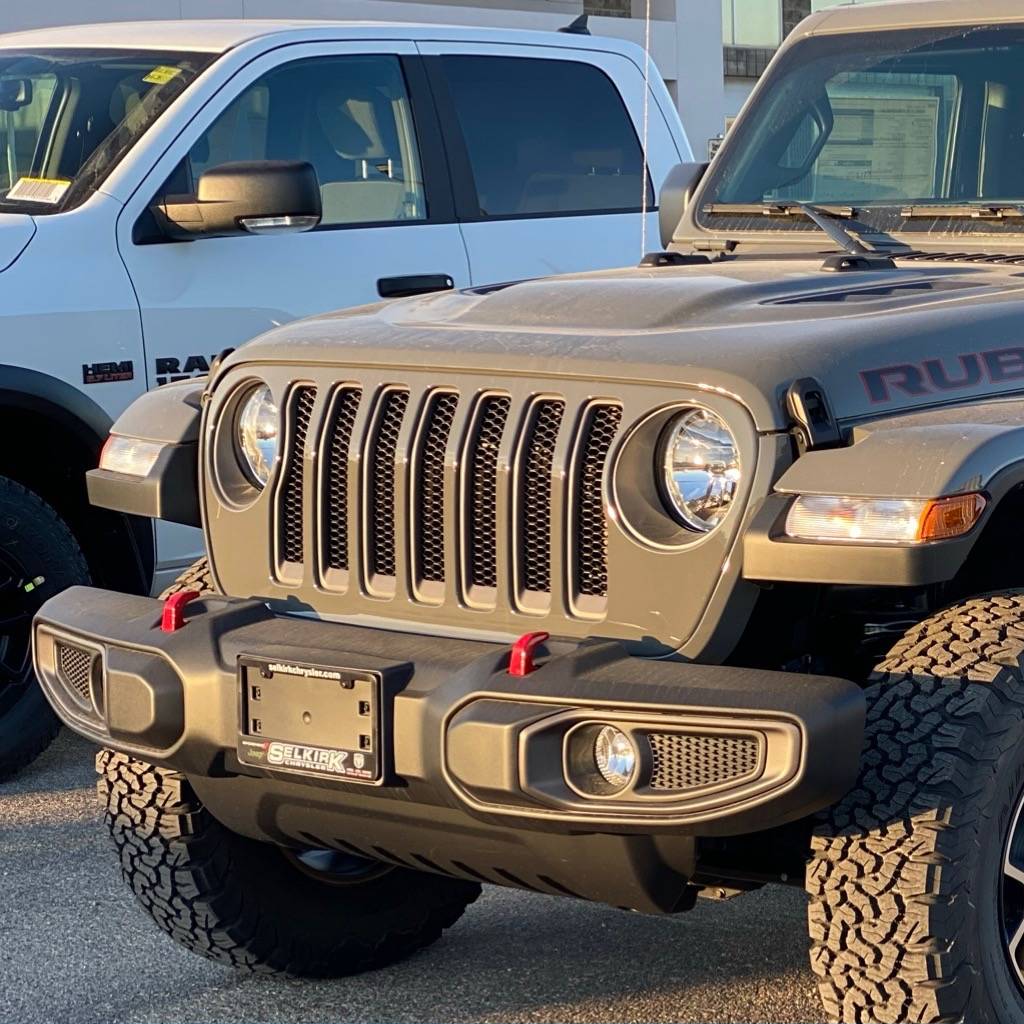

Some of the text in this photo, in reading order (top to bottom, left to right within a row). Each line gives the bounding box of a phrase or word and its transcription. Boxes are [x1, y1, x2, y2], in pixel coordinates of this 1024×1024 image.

[82, 361, 133, 378] HEMI
[156, 354, 217, 375] RA
[268, 663, 341, 680] selkirkchrysler.com
[268, 741, 348, 774] SELKIRK
[284, 759, 329, 772] CHRYSLER
